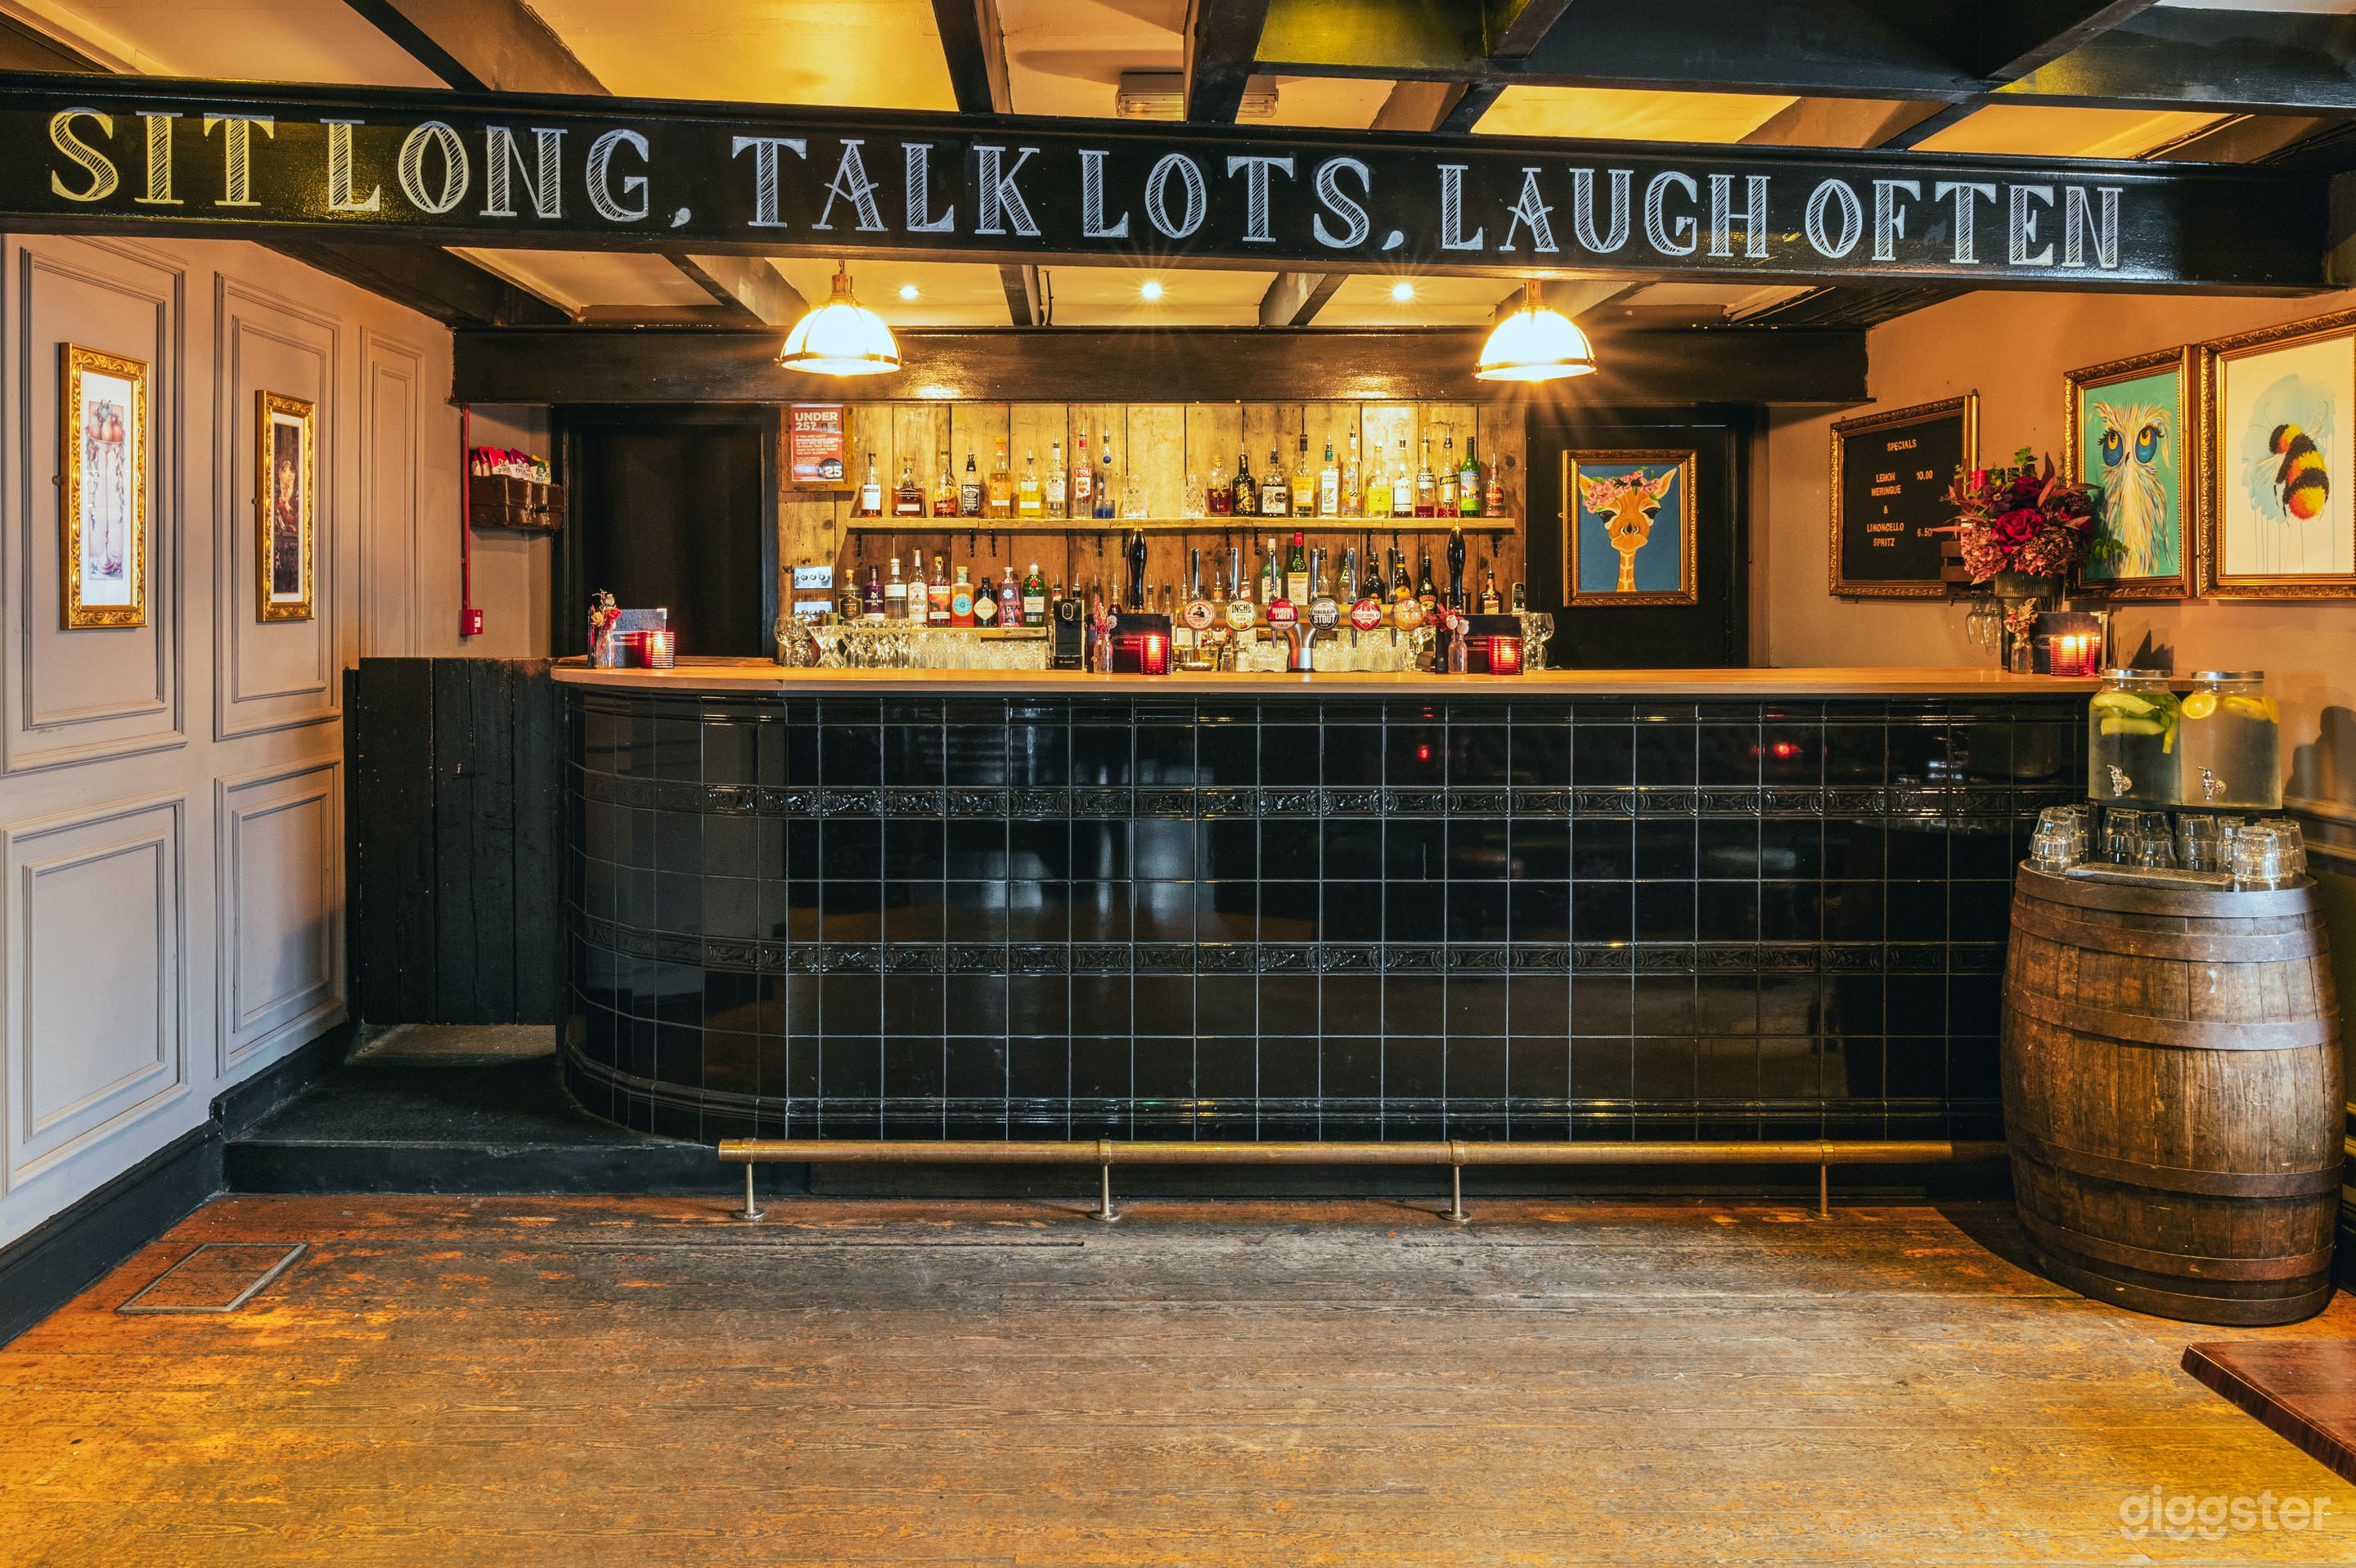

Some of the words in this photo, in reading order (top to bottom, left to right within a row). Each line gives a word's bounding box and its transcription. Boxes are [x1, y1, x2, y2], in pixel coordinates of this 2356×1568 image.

[50, 106, 275, 206] SIT
[320, 118, 692, 227] LONG,
[732, 135, 1041, 236] TALK
[1079, 149, 1405, 251] LOTS,
[1437, 164, 1771, 258] LAUGH
[1805, 177, 2124, 268] OFTEN
[794, 411, 839, 421] UNDER
[795, 421, 817, 431] 25?
[1886, 438, 1917, 452] SPECIALS
[825, 465, 843, 478] 25
[1876, 472, 1895, 483] LEMON
[1916, 470, 1933, 480] 10.00
[1871, 484, 1901, 496] MERINGUE
[1883, 505, 1889, 514] &
[1866, 522, 1904, 532] LIMONCELLO
[1873, 537, 1895, 546] SPRITZ
[1313, 614, 1335, 624] STOUT
